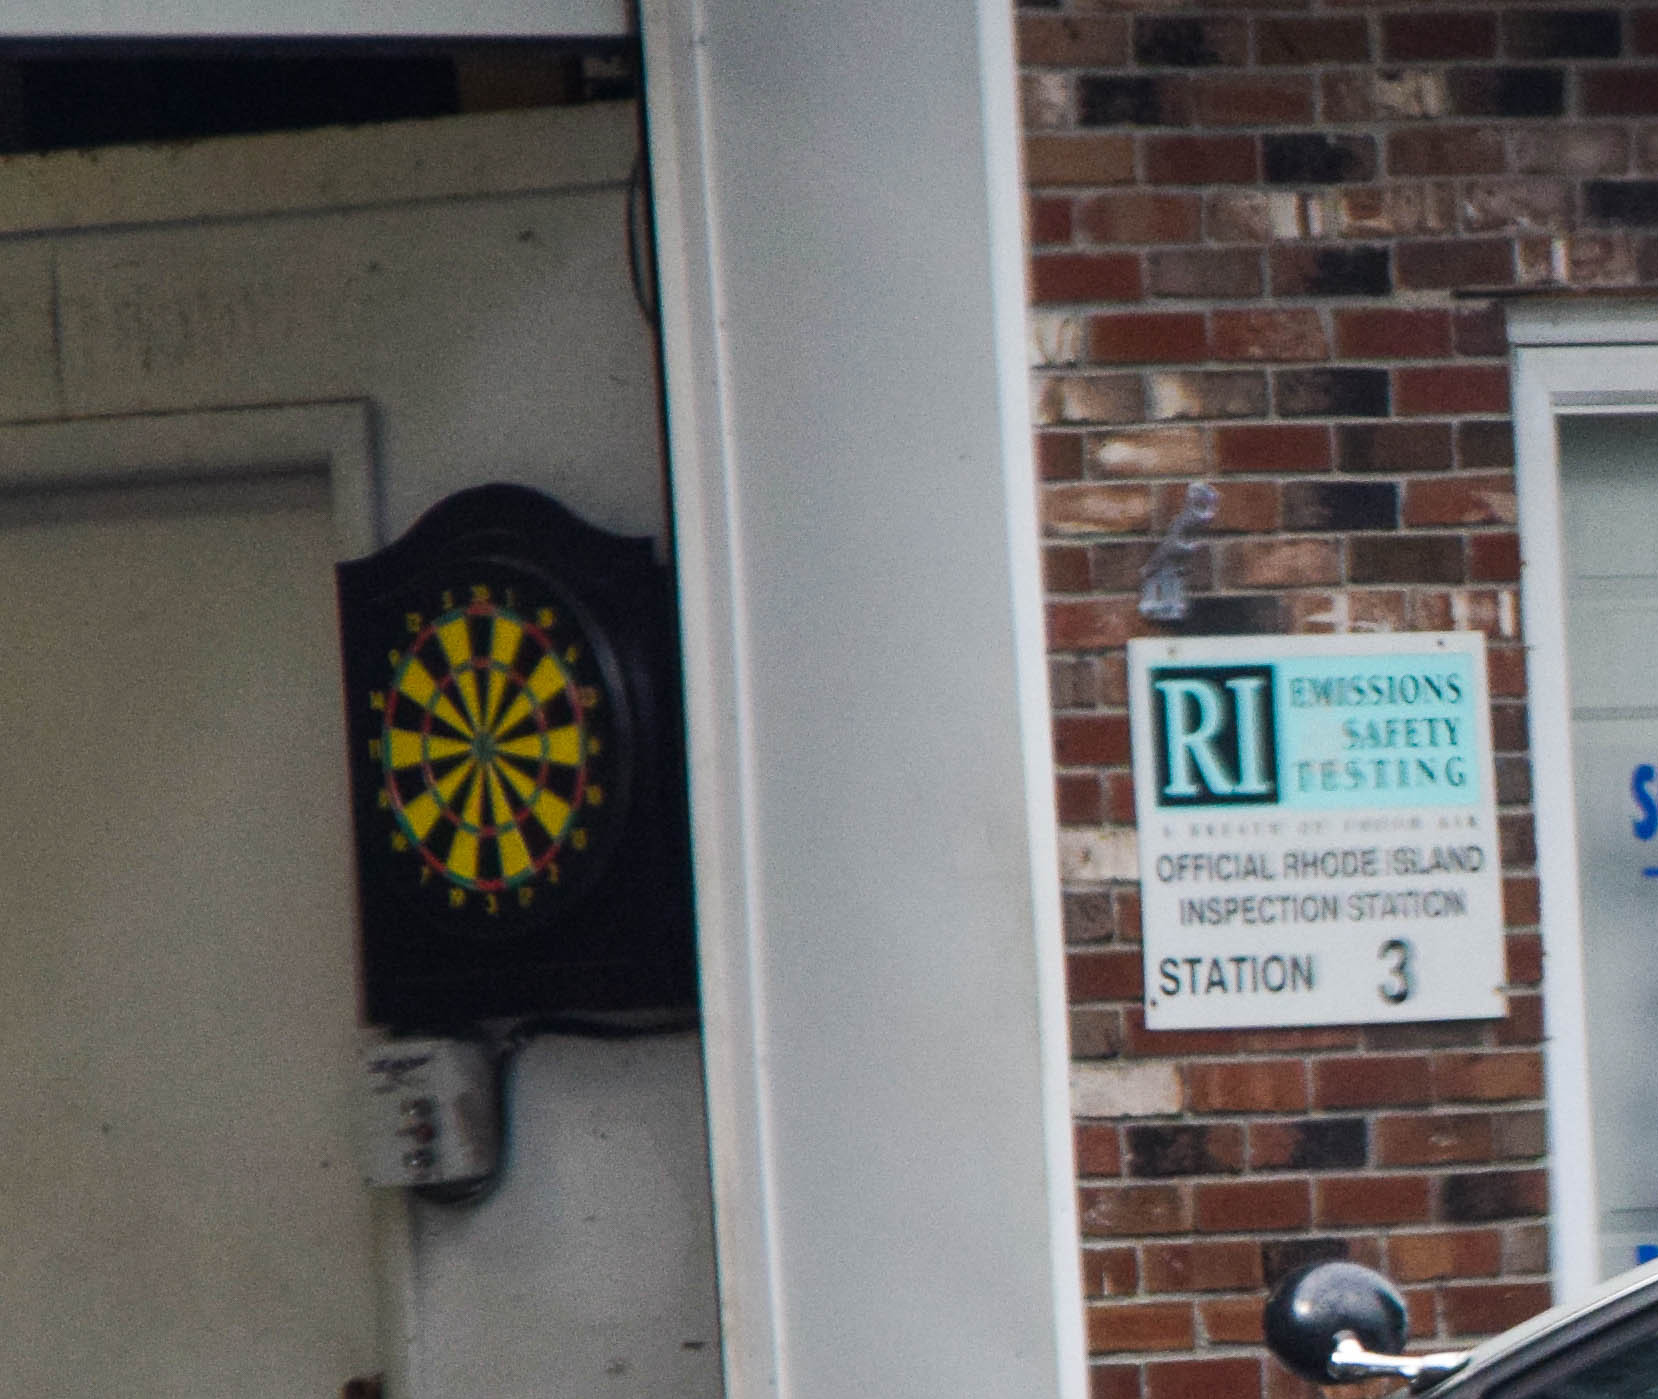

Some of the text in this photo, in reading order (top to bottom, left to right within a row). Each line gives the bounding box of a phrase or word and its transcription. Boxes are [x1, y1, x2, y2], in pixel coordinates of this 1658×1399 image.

[1288, 672, 1463, 709] EMISSIONS
[1154, 676, 1276, 797] RI
[1342, 716, 1461, 751] SAFETY
[1295, 755, 1467, 793] TESTING
[1156, 845, 1485, 883] OFFICIAL RHODE ISLAND
[1179, 889, 1468, 926] INSPECTION STATION
[1159, 938, 1413, 1004] STATION 3
